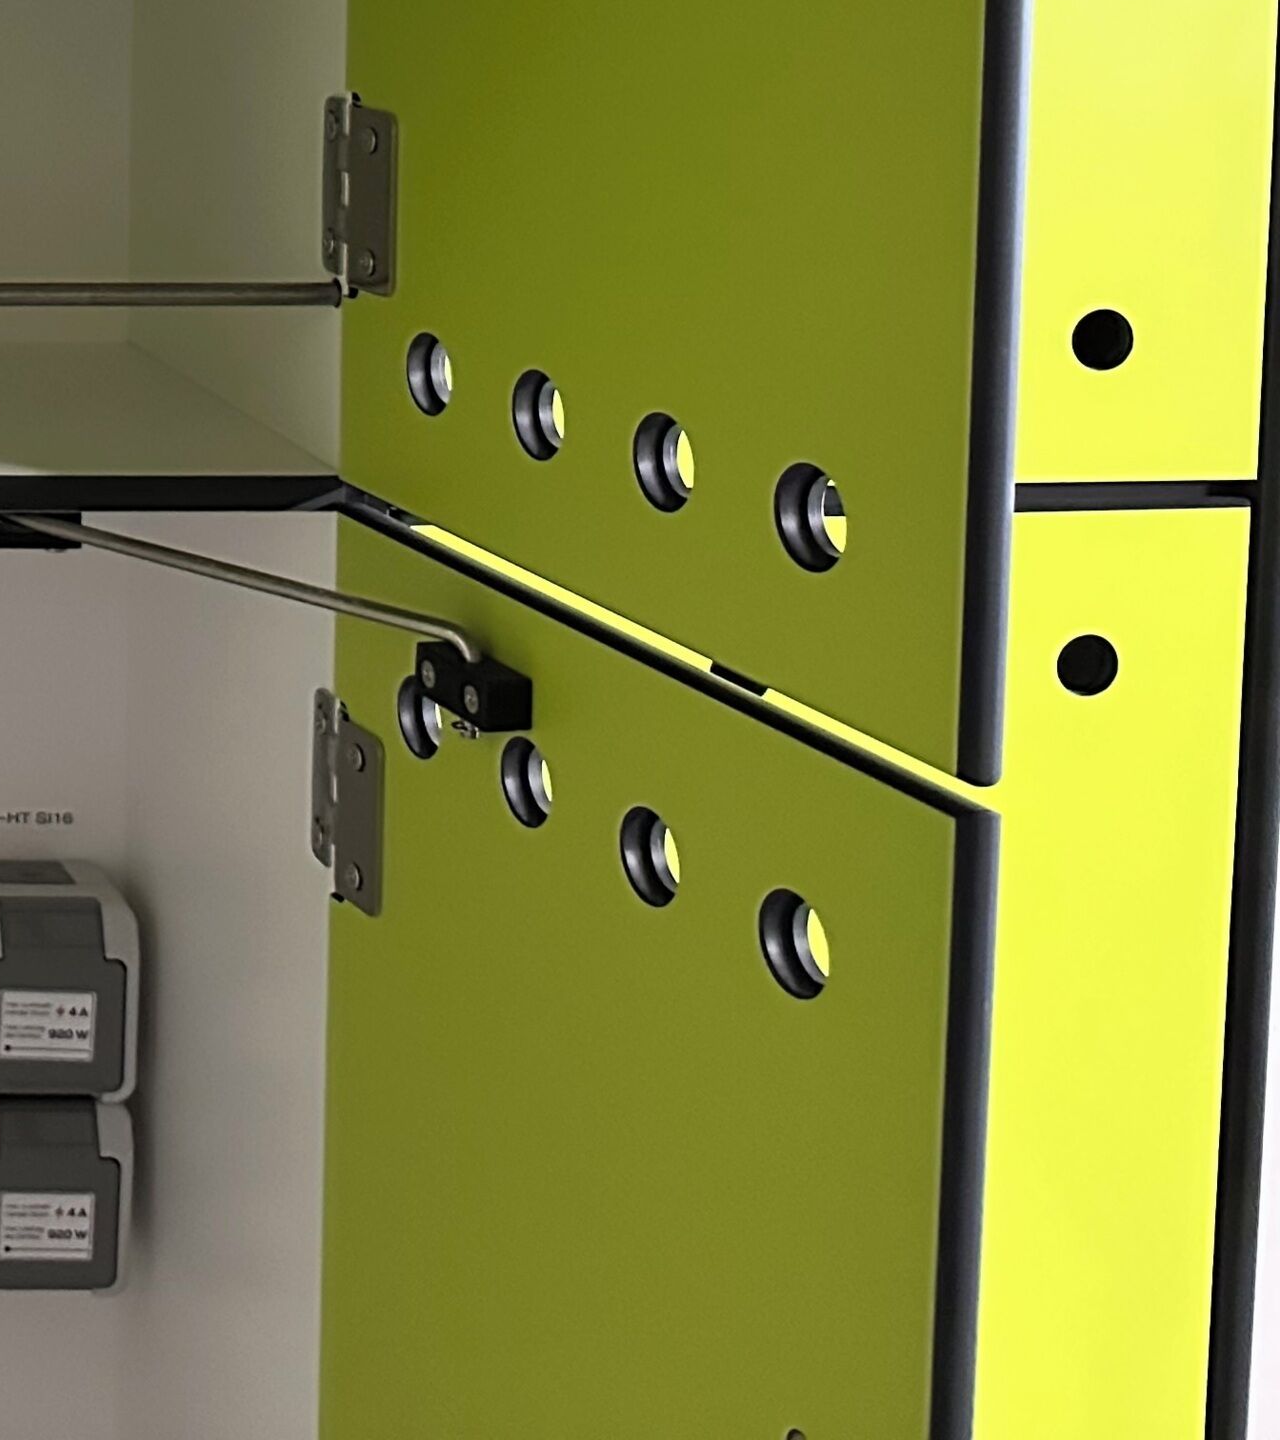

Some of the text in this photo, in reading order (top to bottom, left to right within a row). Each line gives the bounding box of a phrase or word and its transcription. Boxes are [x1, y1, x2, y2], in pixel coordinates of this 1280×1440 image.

[68, 1007, 89, 1017] 4 A
[75, 1029, 89, 1039] W
[67, 1207, 87, 1218] 4 A
[74, 1228, 87, 1239] W
